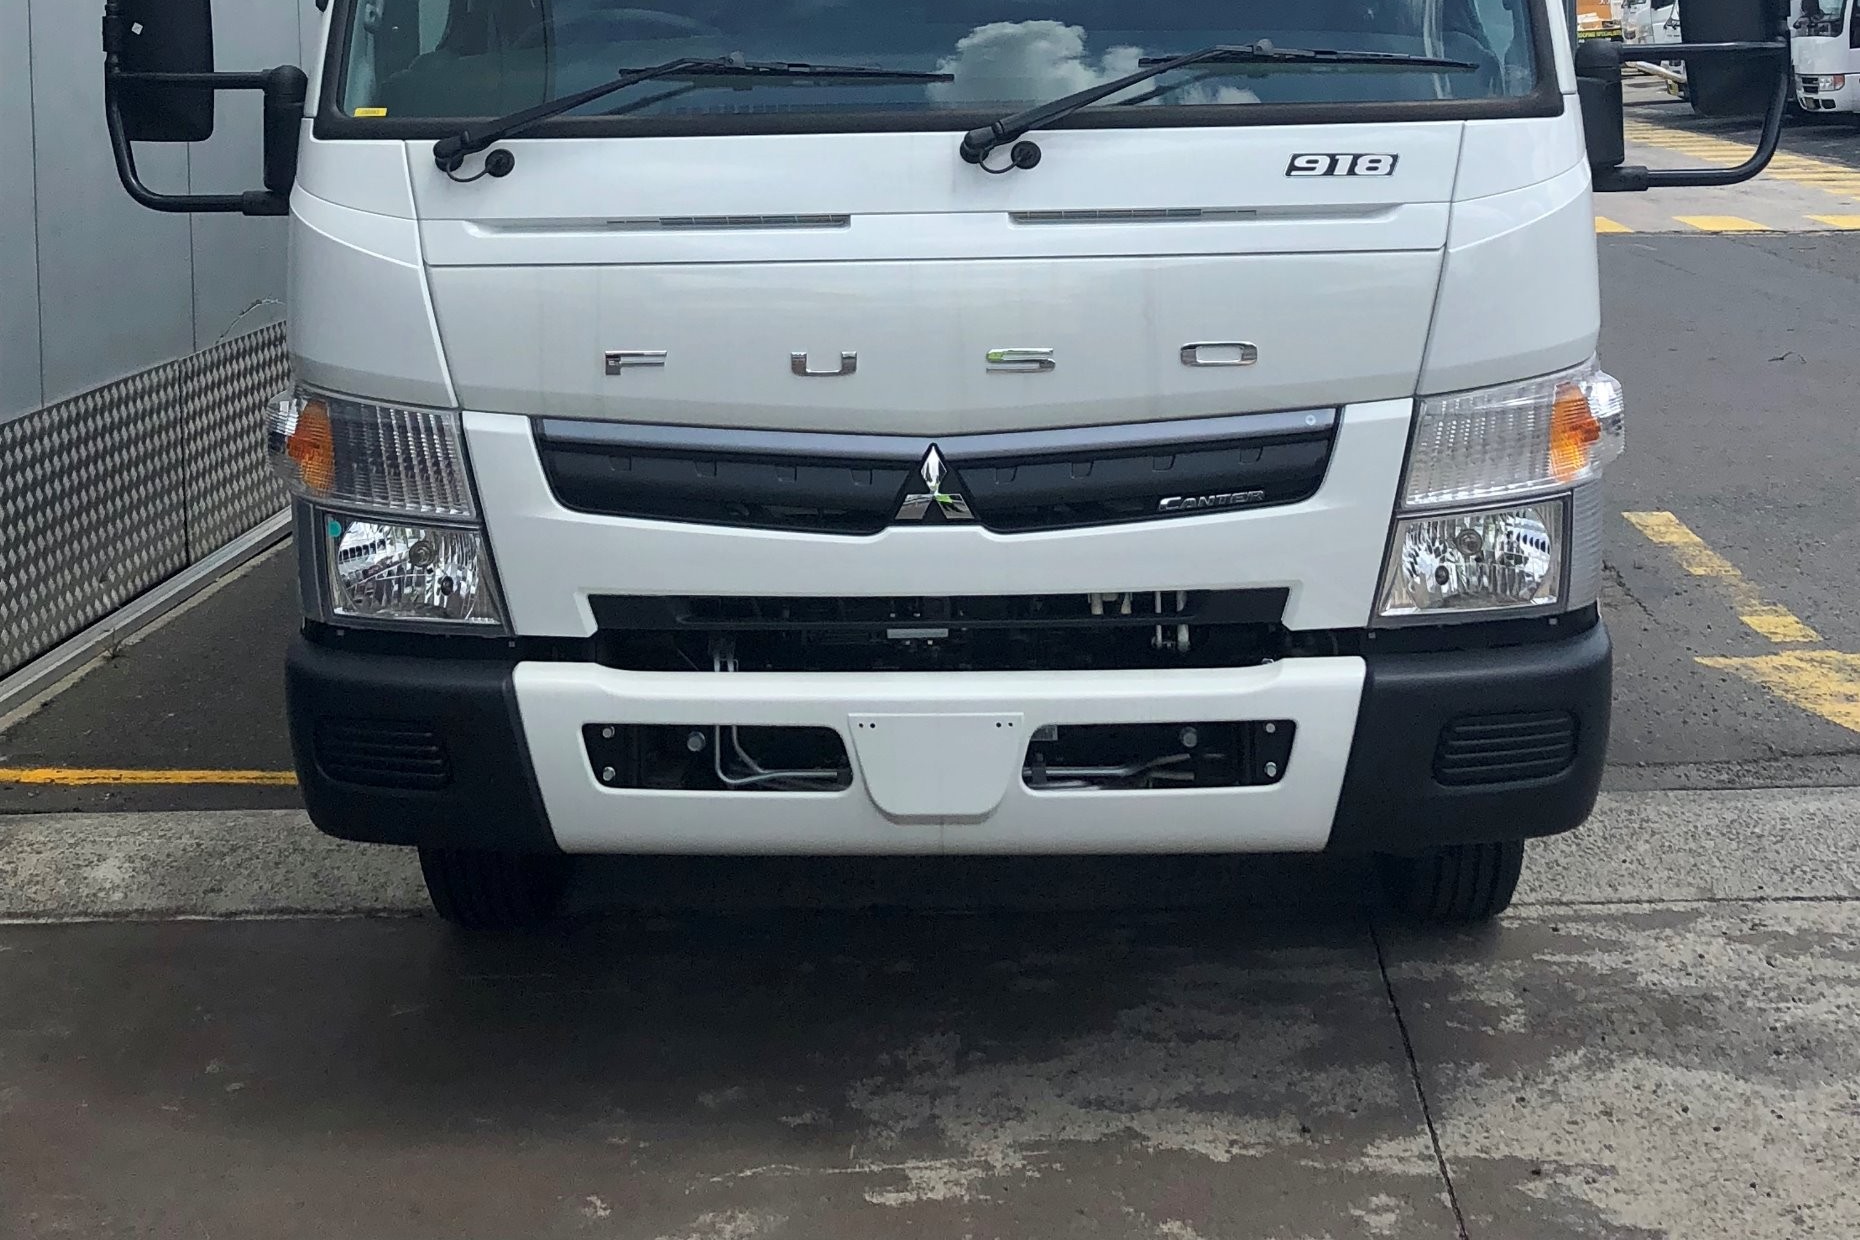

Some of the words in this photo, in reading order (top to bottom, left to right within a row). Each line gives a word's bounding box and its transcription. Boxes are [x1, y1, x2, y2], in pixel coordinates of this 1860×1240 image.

[1289, 154, 1394, 176] 918
[604, 341, 1258, 376] FUSO
[1159, 490, 1264, 510] CANTER
